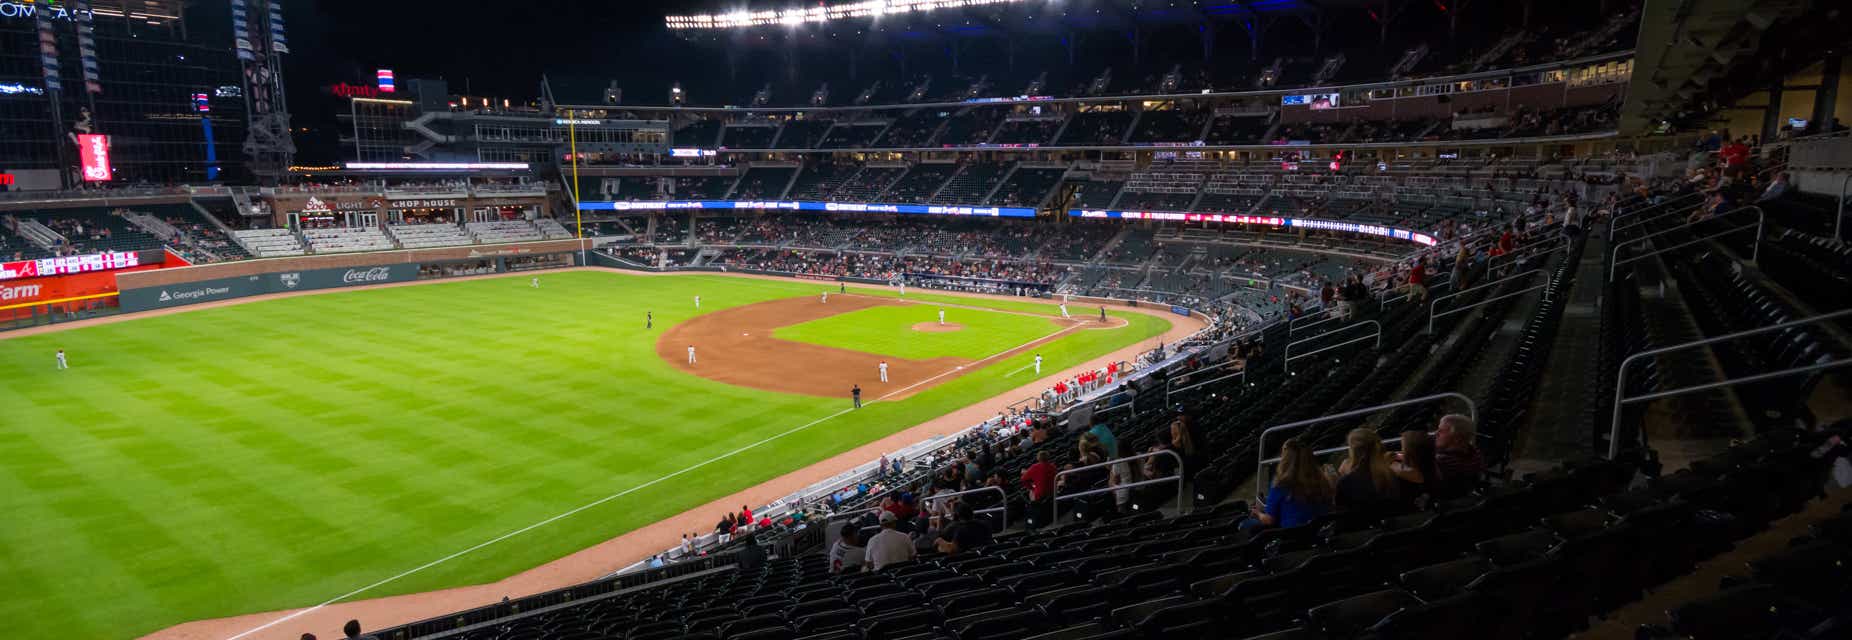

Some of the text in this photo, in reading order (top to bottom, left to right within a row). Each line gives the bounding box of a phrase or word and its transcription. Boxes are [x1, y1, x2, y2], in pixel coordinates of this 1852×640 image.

[392, 200, 420, 208] CHOP
[343, 266, 391, 283] Coca-Cola
[172, 286, 230, 300] Georgia Power
